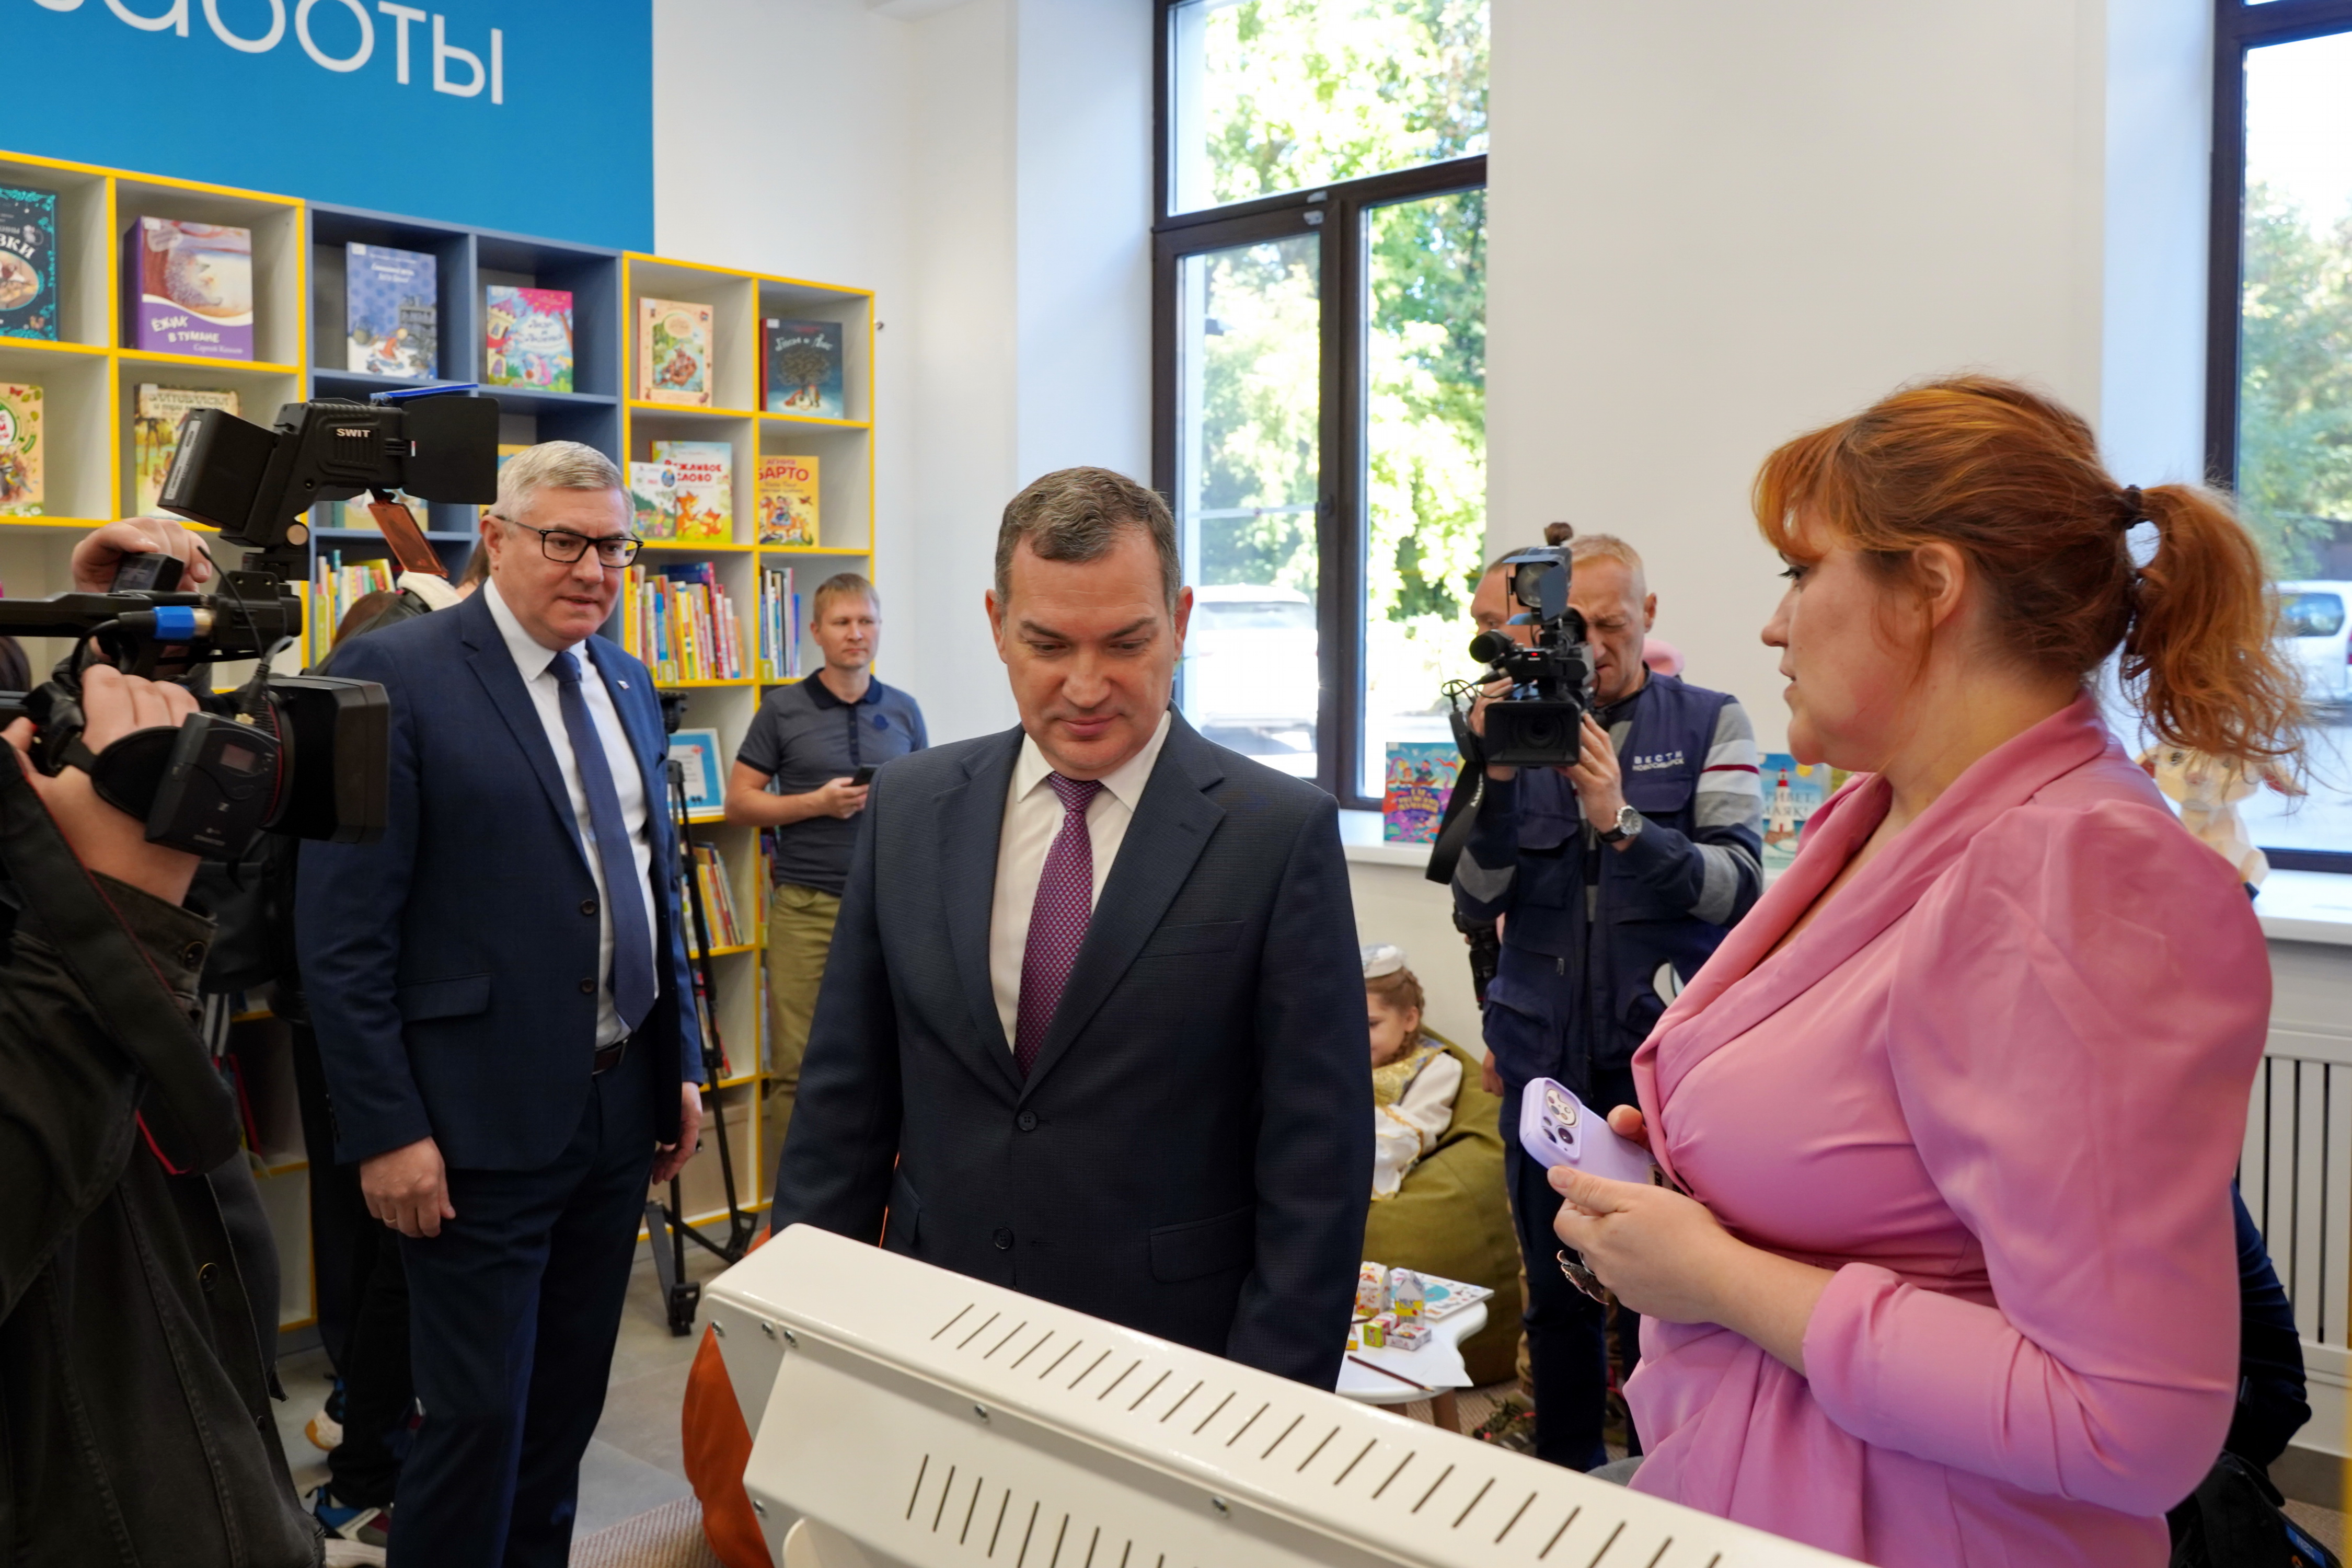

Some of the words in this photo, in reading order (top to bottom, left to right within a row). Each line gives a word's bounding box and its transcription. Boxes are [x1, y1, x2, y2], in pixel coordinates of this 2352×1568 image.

[32, 0, 503, 105] оты
[336, 428, 371, 437] SWIT
[664, 459, 722, 472] ЖЛИВОЕ
[1634, 751, 1682, 764] ВЕСТИ
